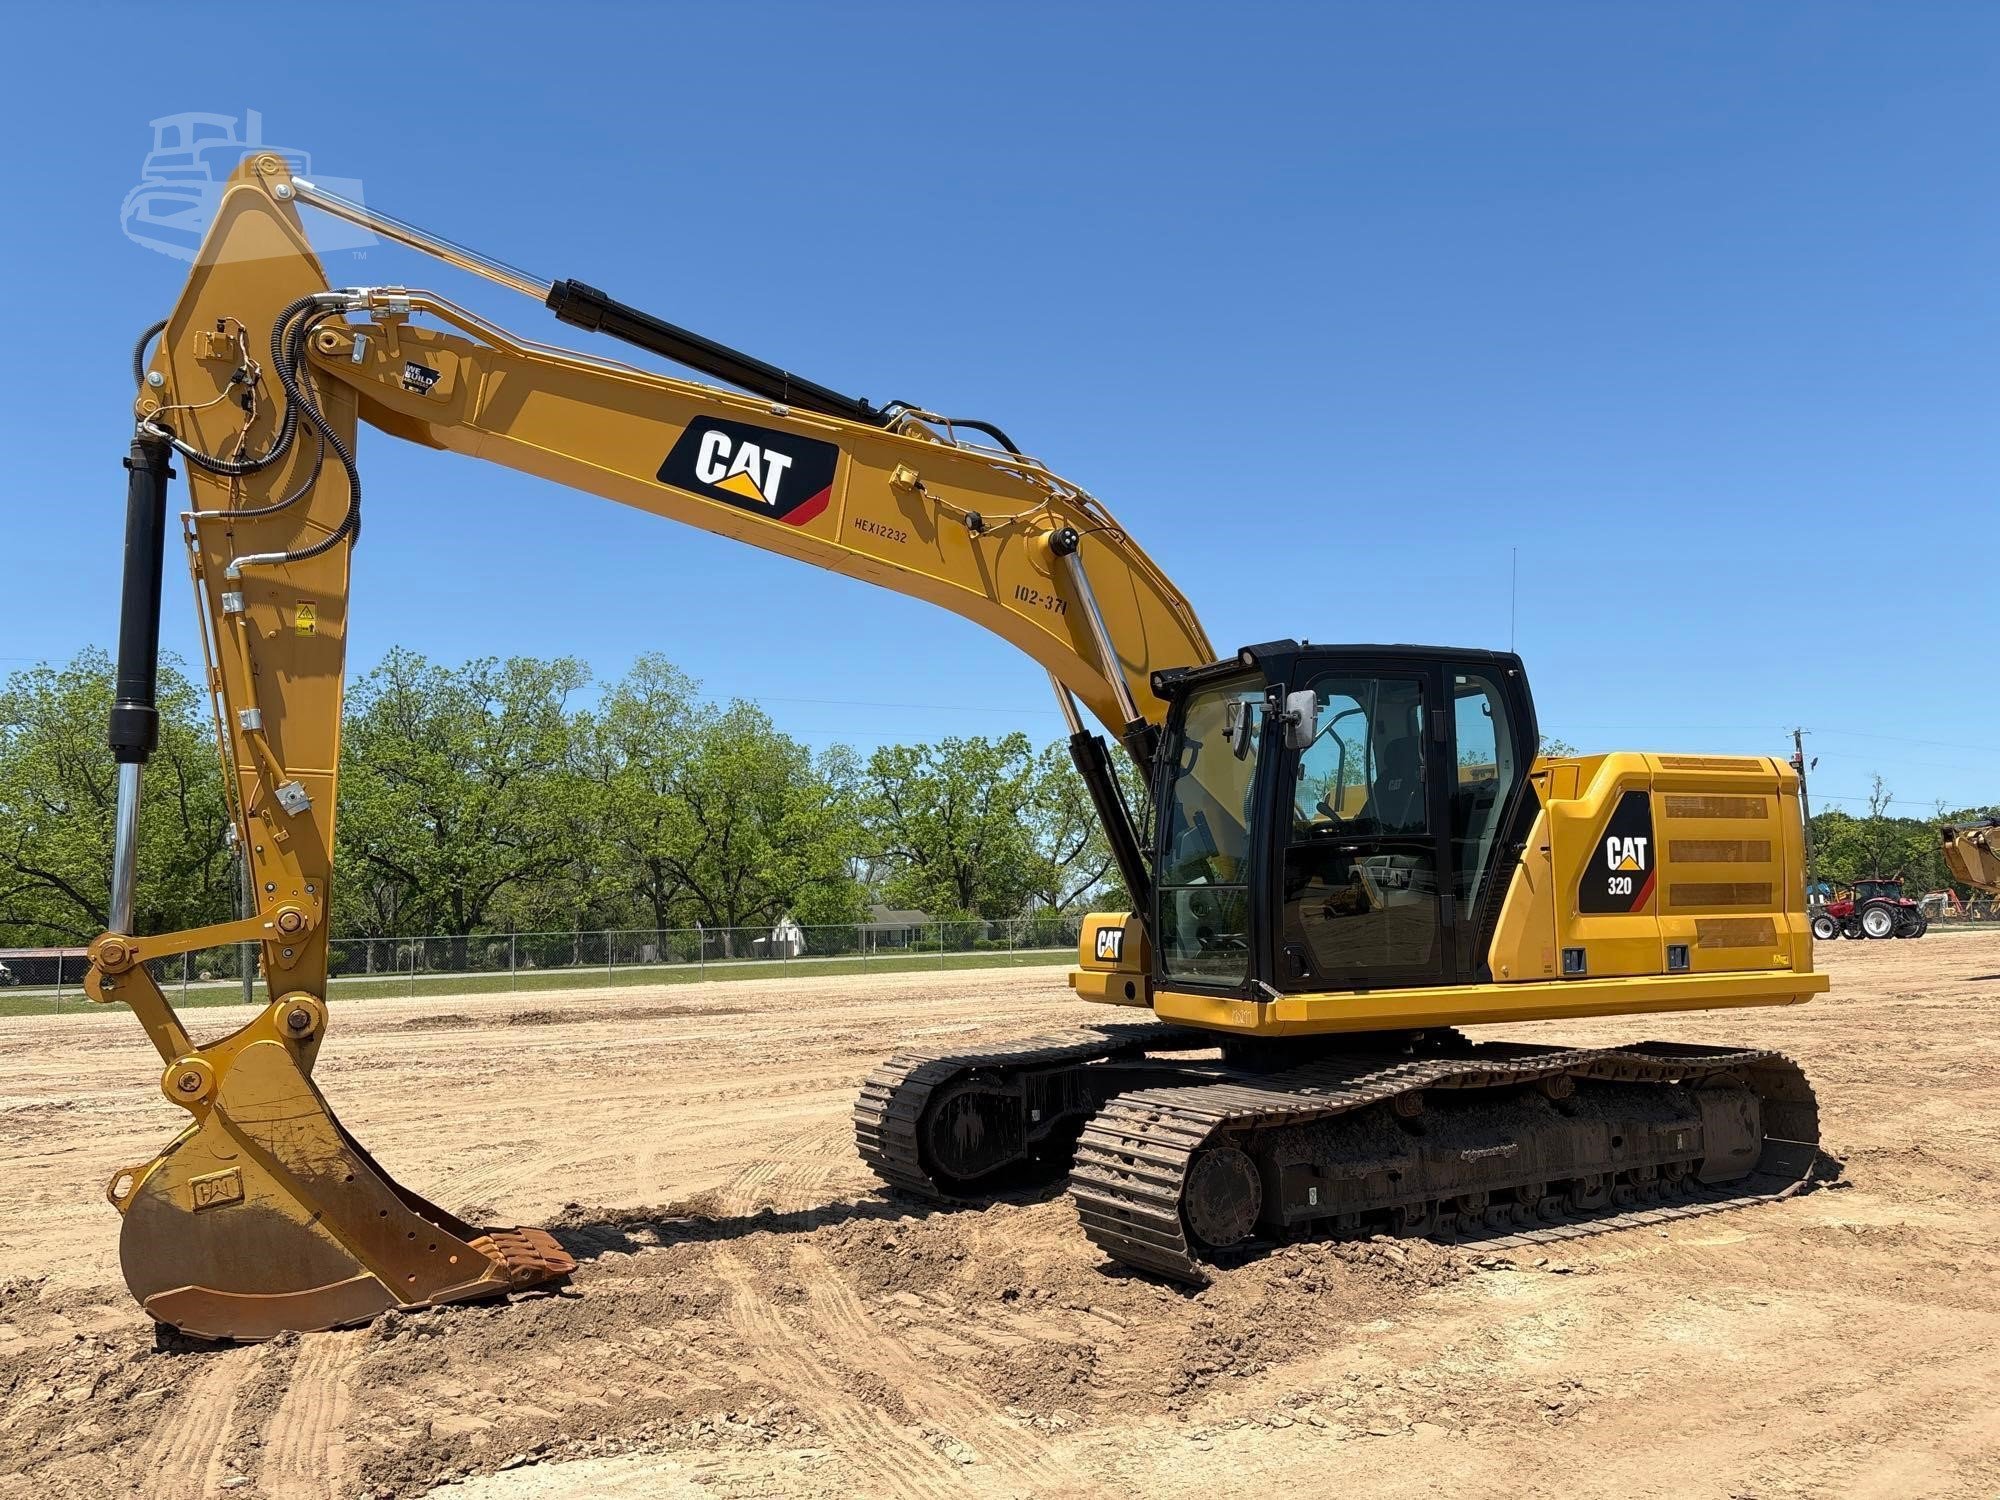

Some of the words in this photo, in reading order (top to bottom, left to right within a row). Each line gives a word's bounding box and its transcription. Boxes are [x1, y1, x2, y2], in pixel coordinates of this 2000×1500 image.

[405, 371, 433, 385] BUILD
[406, 364, 421, 375] WE
[695, 429, 793, 506] CAT
[854, 517, 908, 544] HEX12232
[1014, 584, 1068, 616] 102-371
[1606, 836, 1648, 871] CAT
[1607, 876, 1633, 895] 320
[1097, 930, 1122, 959] CAT
[194, 1174, 239, 1207] CAT
